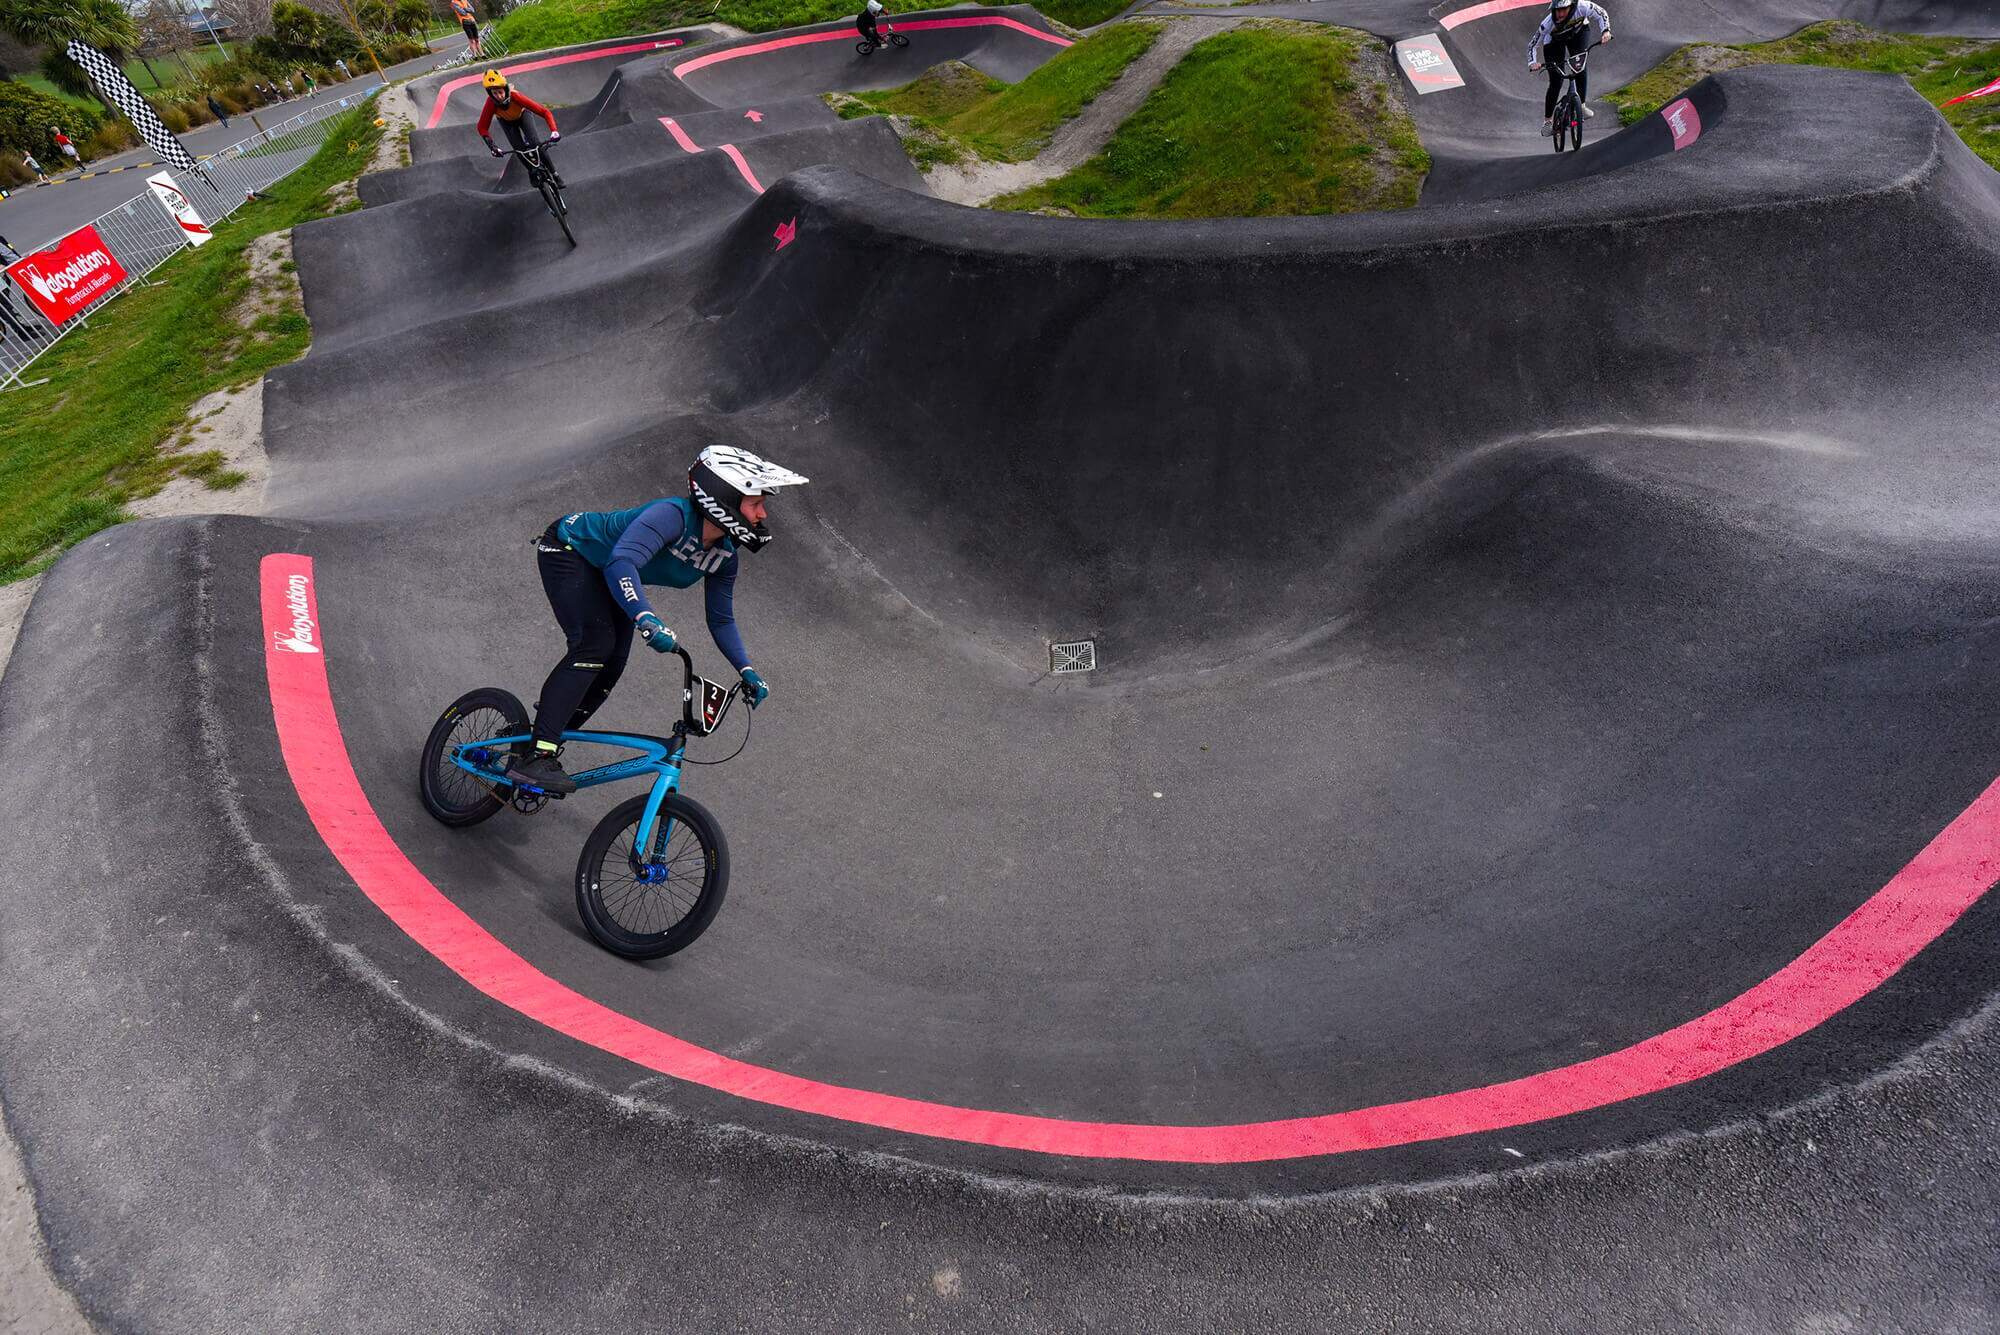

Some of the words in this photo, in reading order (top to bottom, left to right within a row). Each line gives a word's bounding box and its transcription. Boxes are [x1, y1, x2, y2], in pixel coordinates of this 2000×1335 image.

[1406, 49, 1432, 61] PUMP
[1410, 54, 1442, 67] TRACK
[18, 249, 111, 303] Velosolutions
[619, 576, 639, 602] LEATT
[273, 574, 320, 653] Velosolutions
[711, 686, 718, 700] 2
